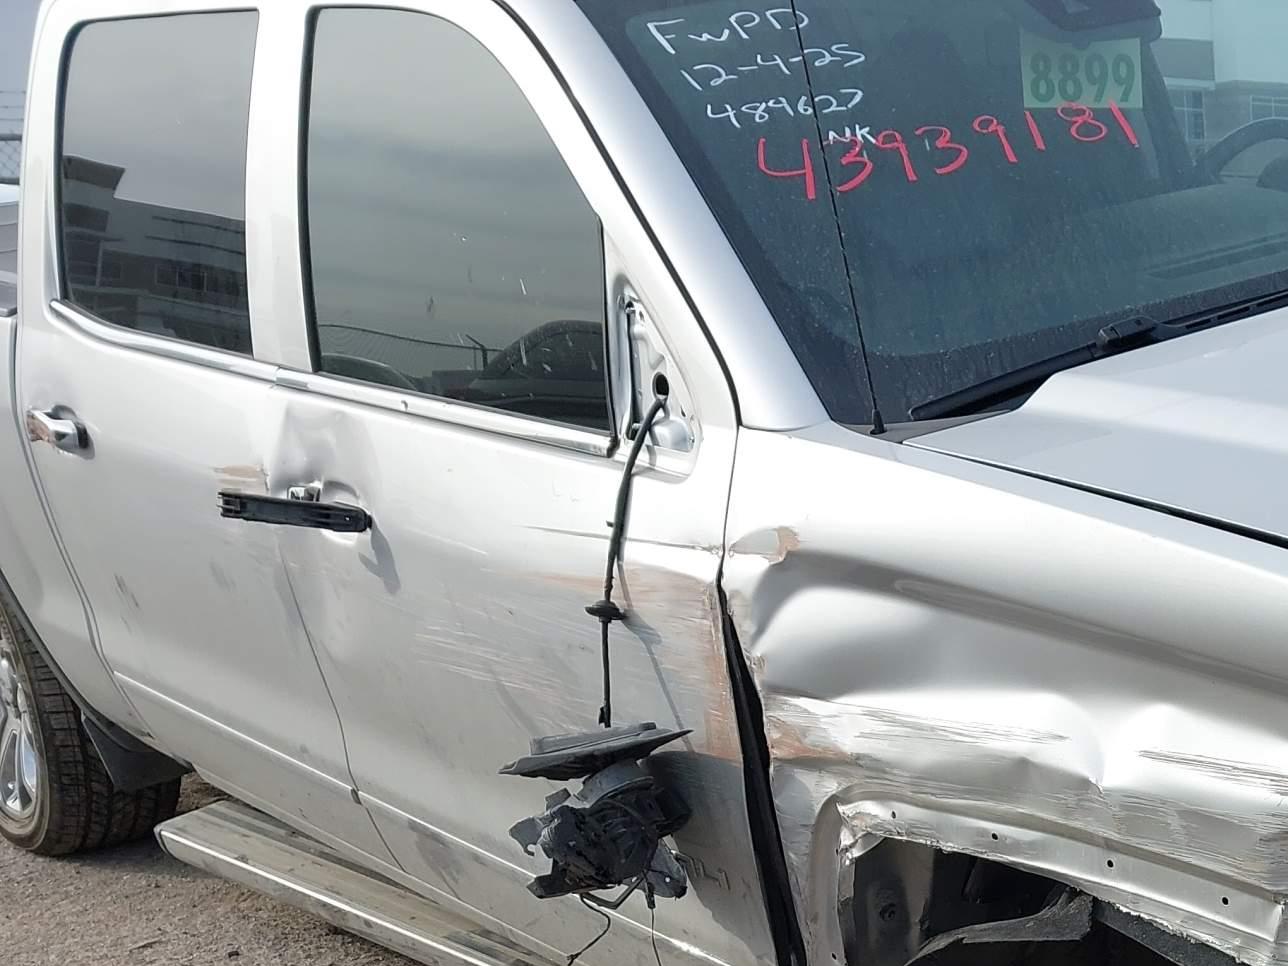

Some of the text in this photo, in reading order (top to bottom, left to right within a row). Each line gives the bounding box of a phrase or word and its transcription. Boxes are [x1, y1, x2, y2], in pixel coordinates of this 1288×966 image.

[680, 43, 866, 91] 12-4-25
[1029, 51, 1136, 104] 8899
[706, 88, 864, 129] 489627
[757, 99, 1140, 200] 43939181
